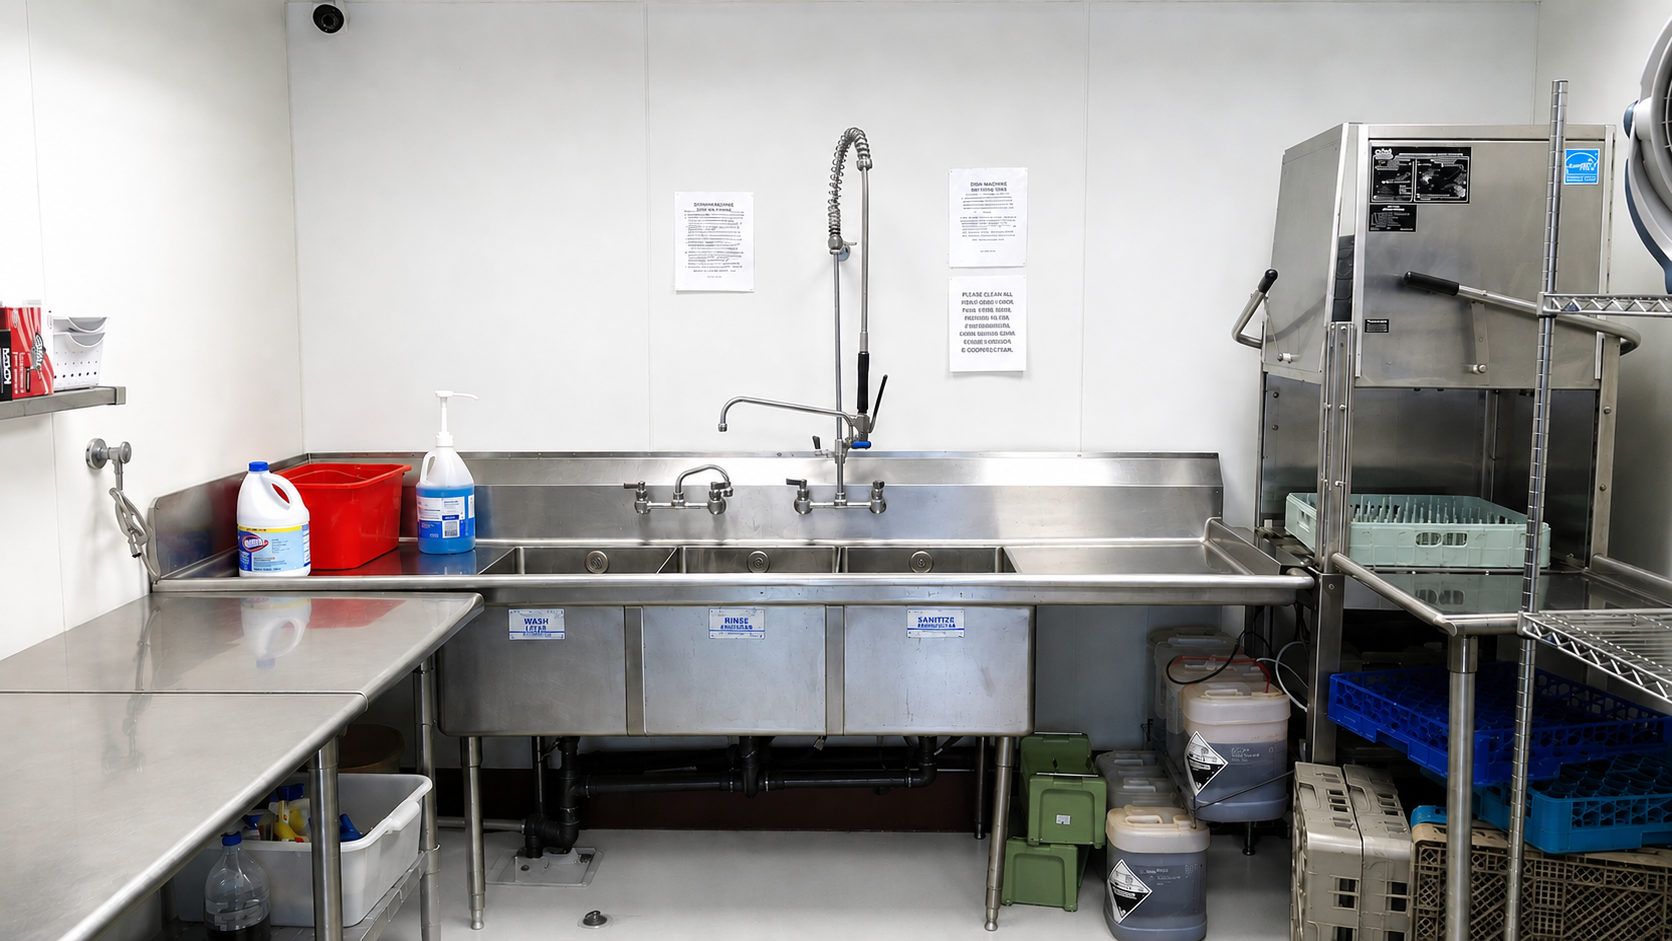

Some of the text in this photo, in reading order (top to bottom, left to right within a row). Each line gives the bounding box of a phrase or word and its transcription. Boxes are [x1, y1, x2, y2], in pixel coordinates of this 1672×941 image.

[524, 617, 549, 625] WASH
[724, 617, 749, 625] RINSE
[917, 616, 955, 624] SANITIZE
